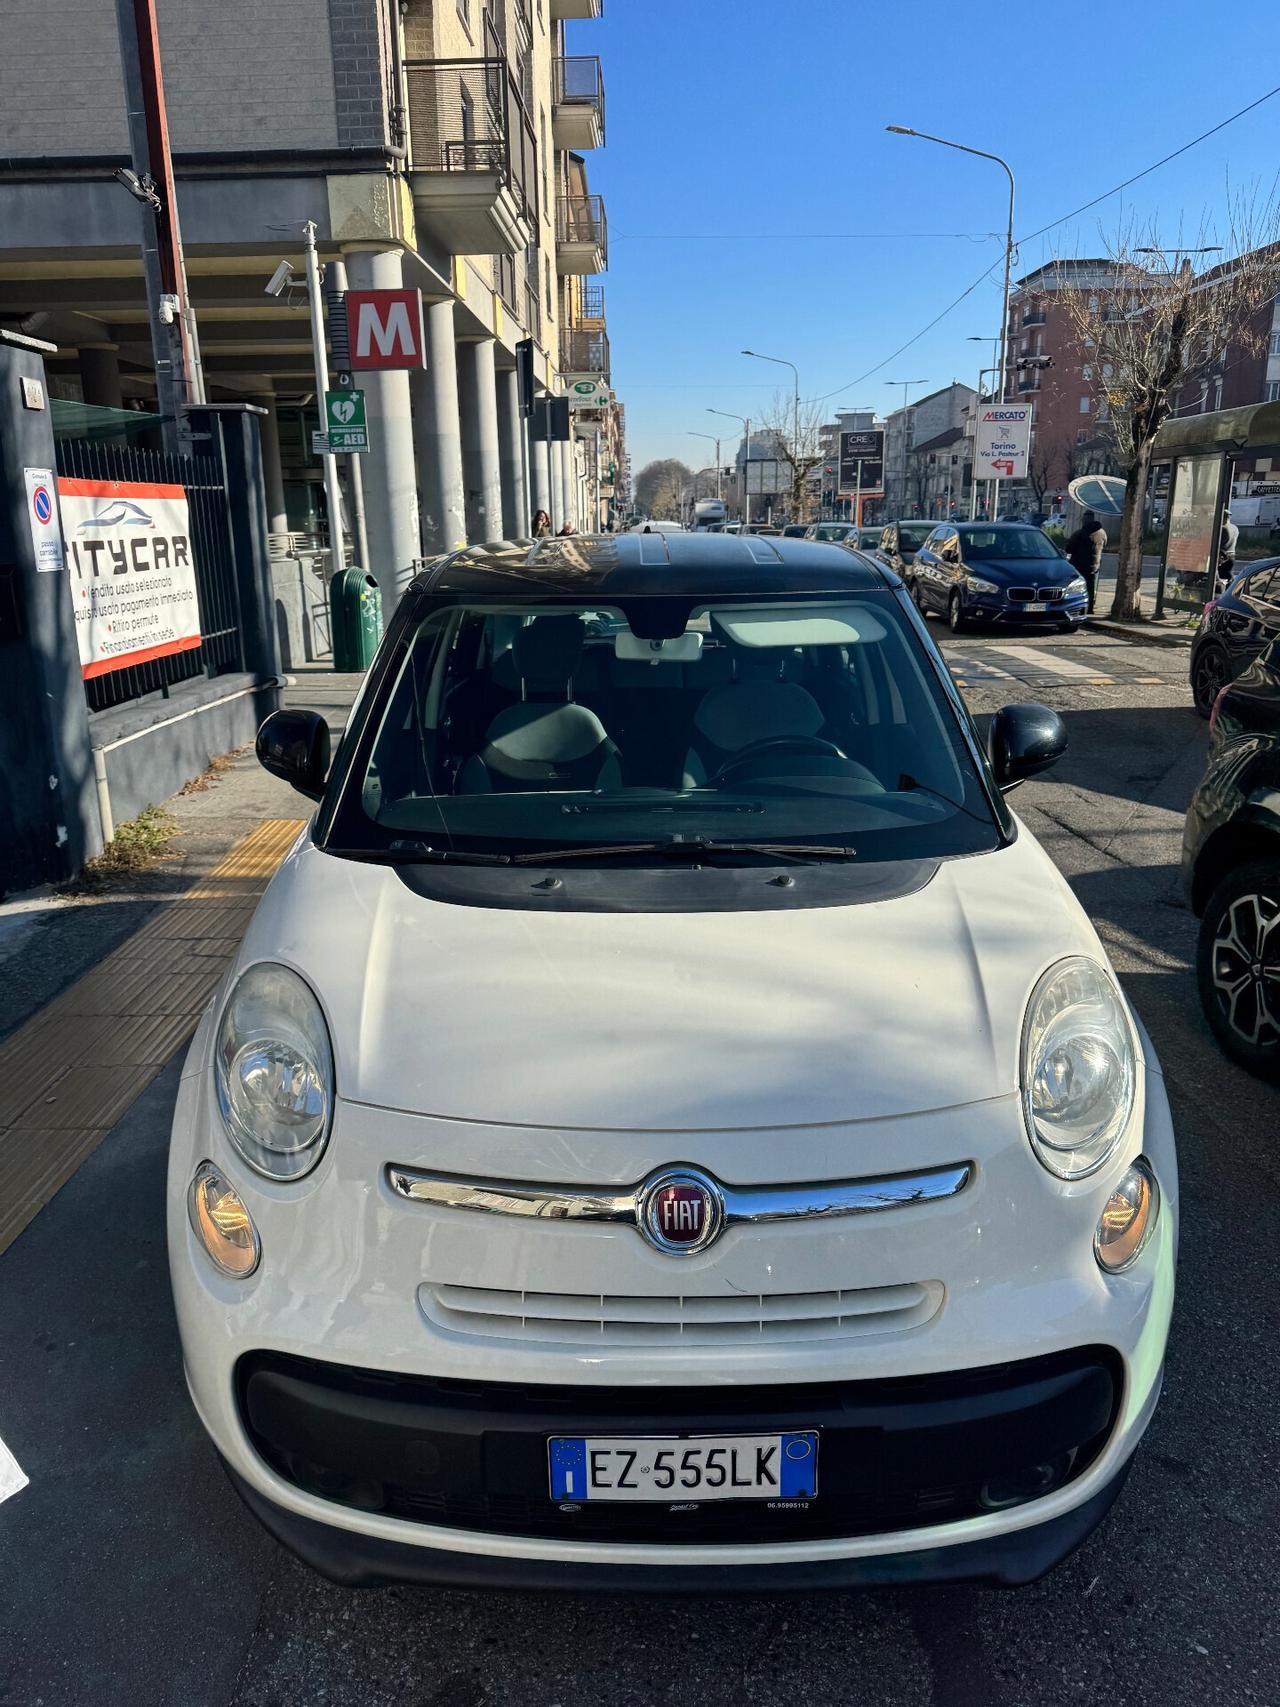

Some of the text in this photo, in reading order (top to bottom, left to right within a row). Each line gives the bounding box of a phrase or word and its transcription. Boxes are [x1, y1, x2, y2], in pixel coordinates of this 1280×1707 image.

[356, 302, 417, 357] M
[983, 411, 1026, 421] MERCATO
[343, 433, 366, 446] AED
[991, 442, 1017, 450] Torino
[64, 536, 189, 578] ITYCAR
[116, 582, 135, 595] usato
[136, 577, 172, 592] selezionato
[98, 603, 119, 617] usato
[121, 596, 160, 615] pagamento
[160, 589, 194, 605] immediato
[112, 613, 159, 633] Ritiro permute
[663, 1199, 701, 1230] FIAT
[589, 1446, 778, 1488] EZ 555LK
